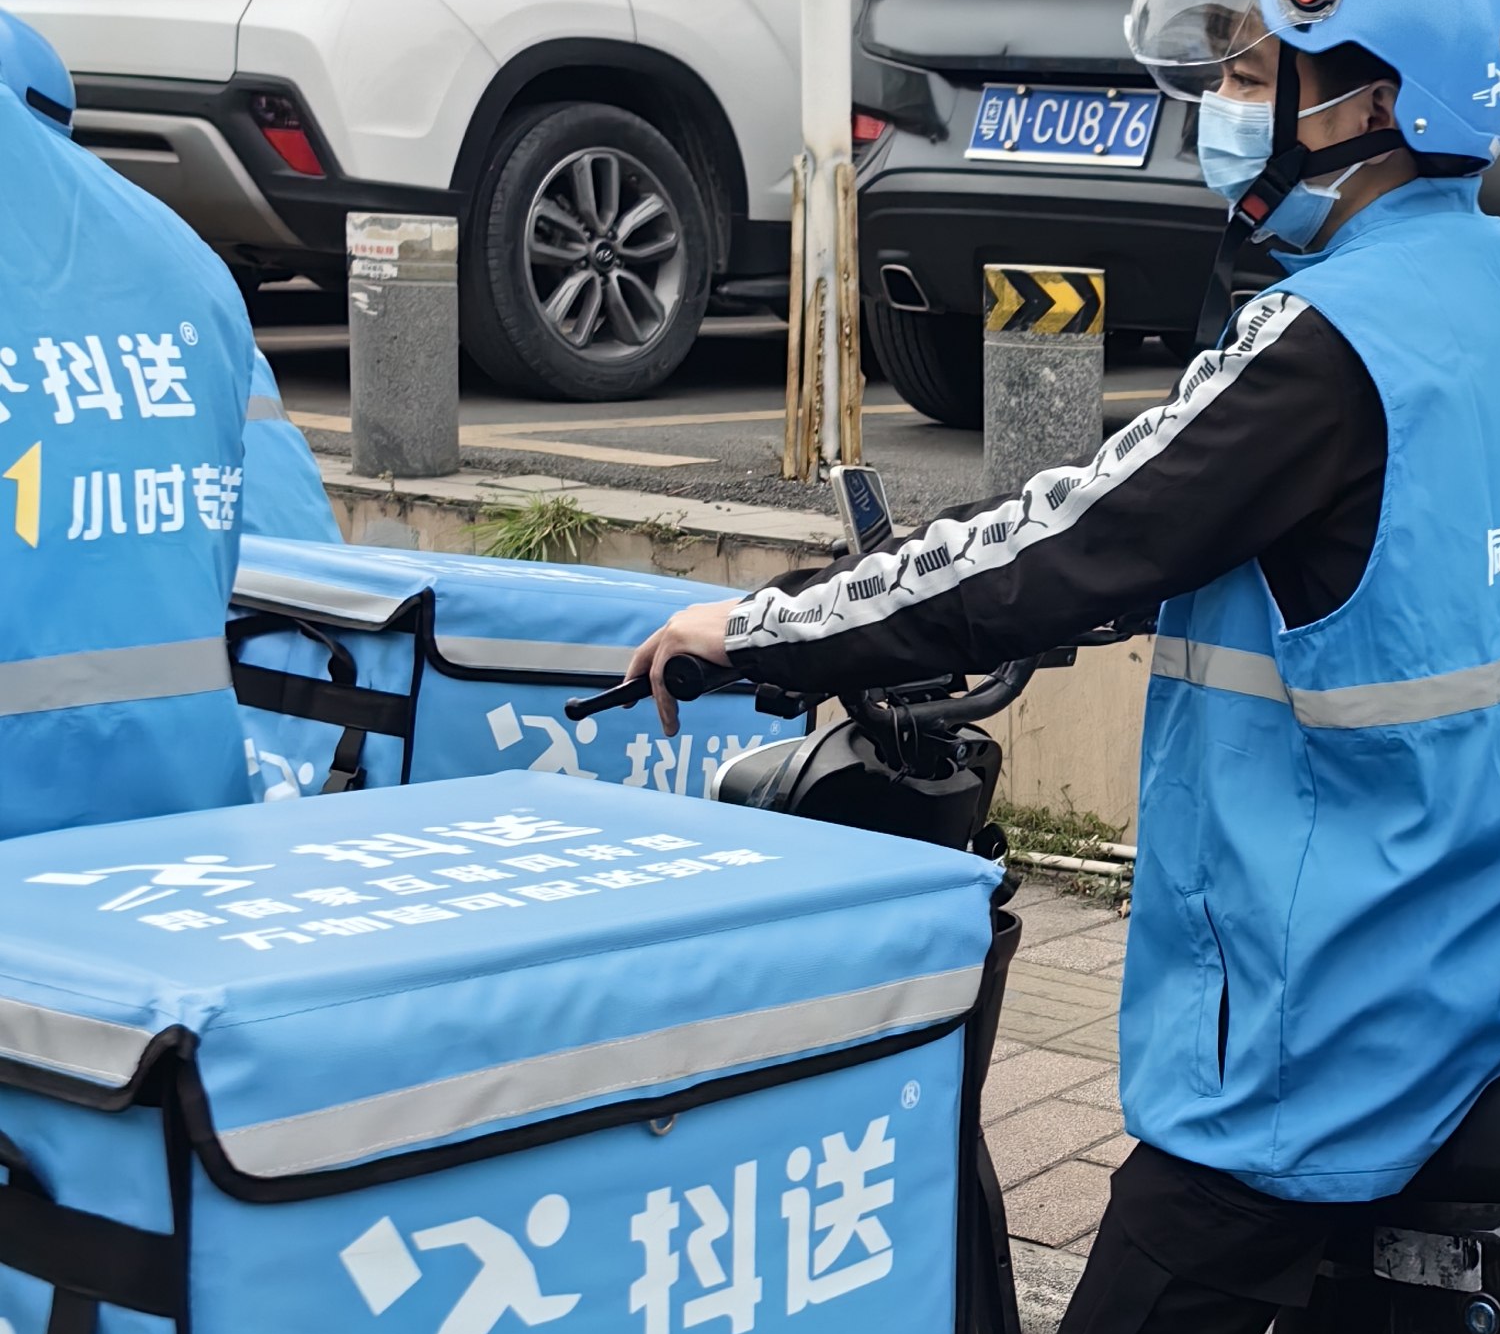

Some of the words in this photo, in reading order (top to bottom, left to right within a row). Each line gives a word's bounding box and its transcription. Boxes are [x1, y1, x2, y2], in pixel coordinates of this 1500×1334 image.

[1238, 304, 1277, 353] PUMA
[1183, 356, 1217, 404] PUMA
[1114, 417, 1154, 462] PUMA
[846, 571, 888, 603] PUMA
[778, 604, 824, 624] PUMA
[137, 833, 703, 932] 帮商家互联网转型
[219, 849, 784, 951] 万物皆可配送到家
